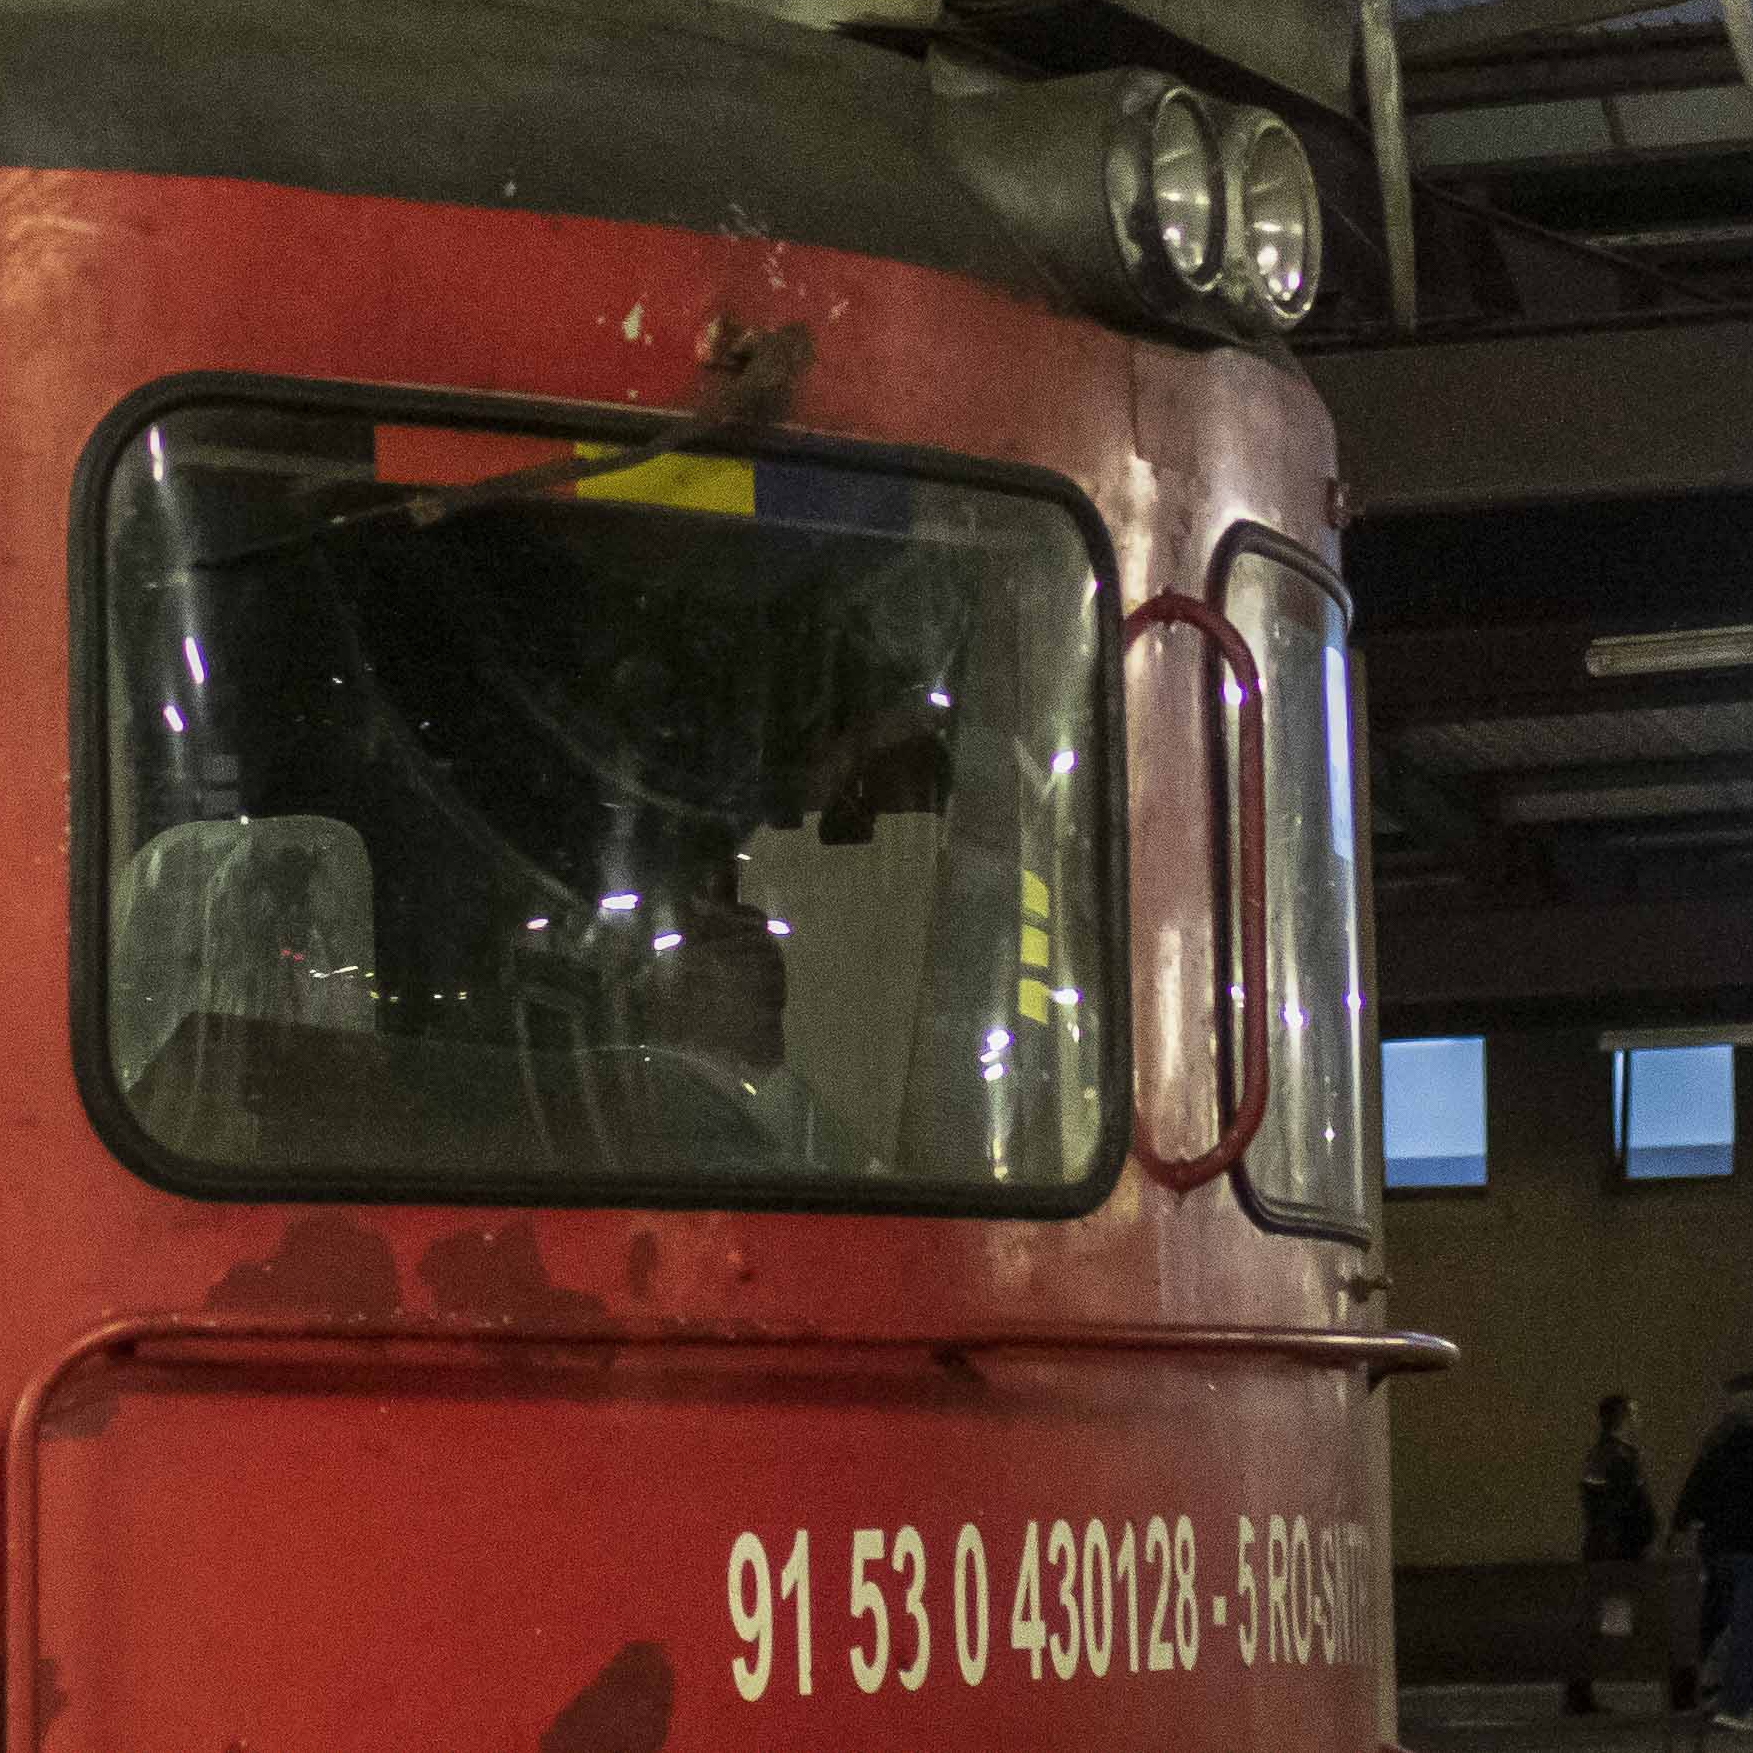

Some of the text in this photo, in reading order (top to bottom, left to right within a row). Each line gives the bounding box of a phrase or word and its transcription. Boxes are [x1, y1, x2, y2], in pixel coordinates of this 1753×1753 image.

[726, 1529, 813, 1703] 91
[848, 1524, 931, 1695] 53
[953, 1521, 990, 1687] 0
[1010, 1514, 1200, 1681] 430128
